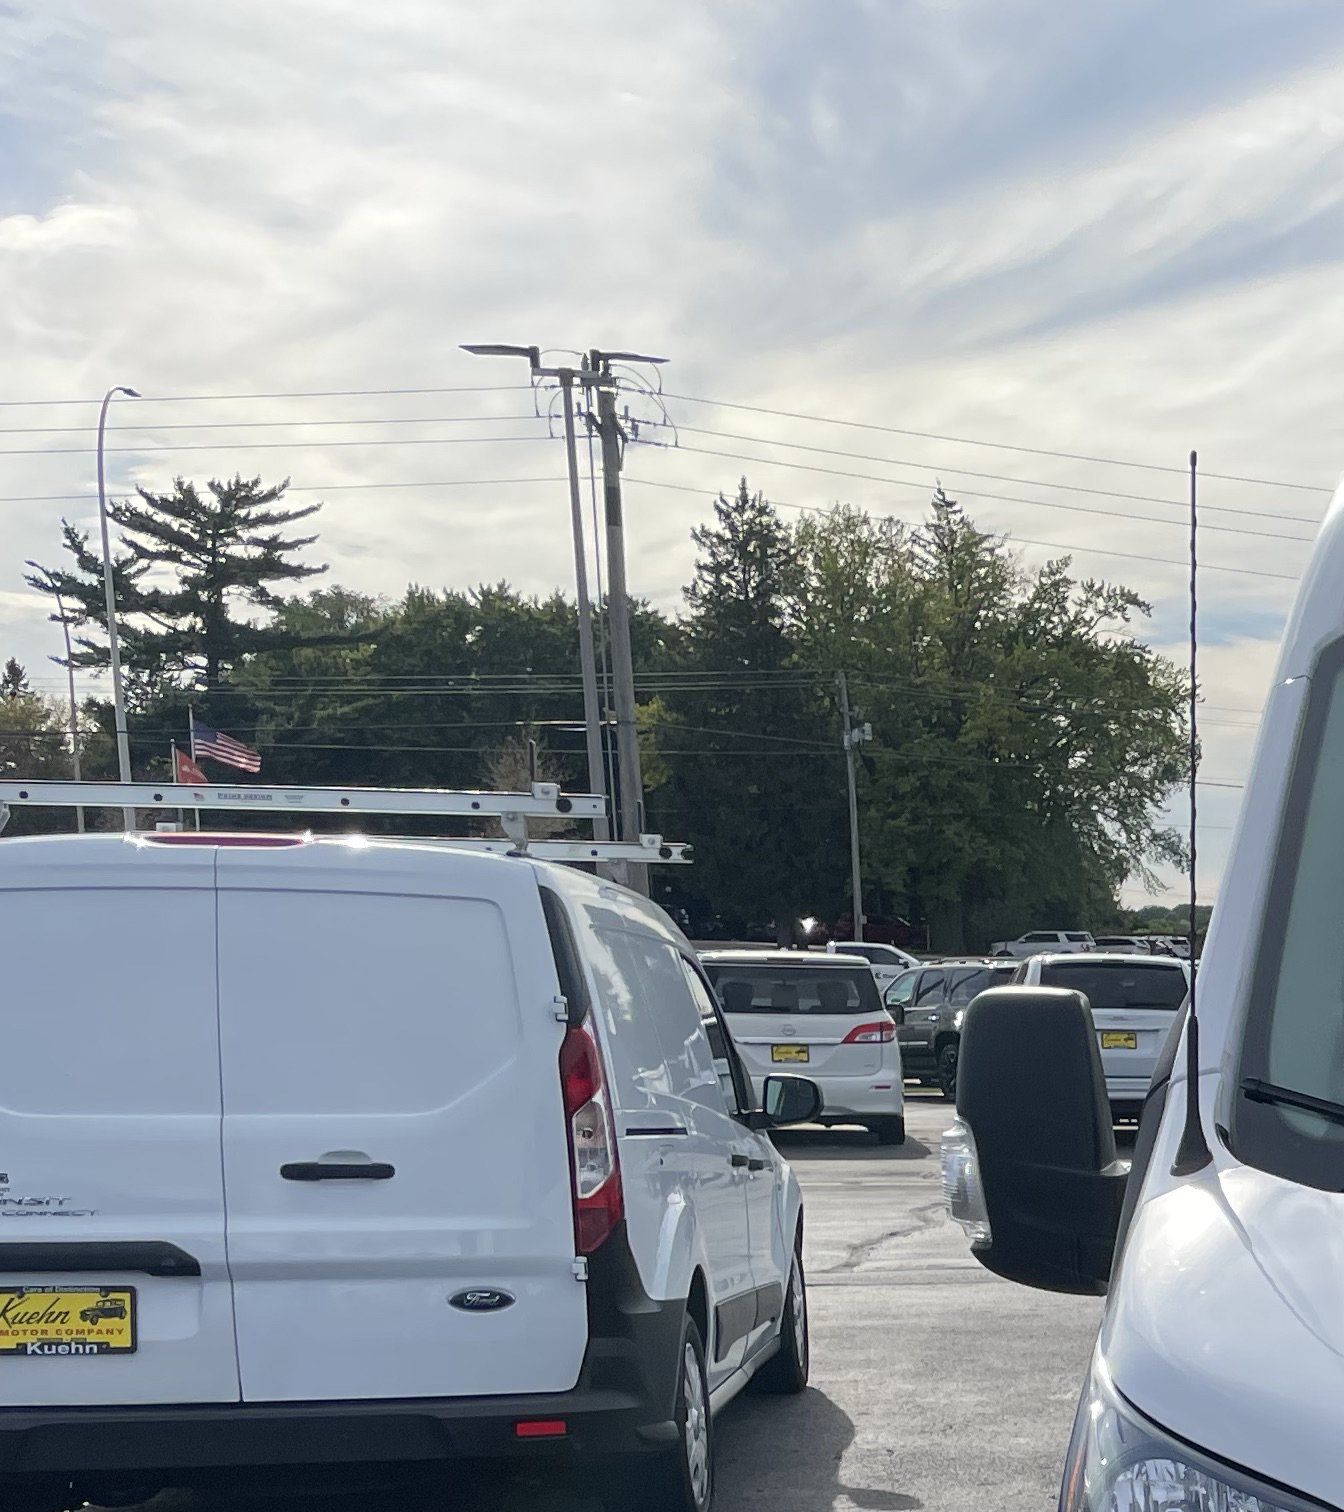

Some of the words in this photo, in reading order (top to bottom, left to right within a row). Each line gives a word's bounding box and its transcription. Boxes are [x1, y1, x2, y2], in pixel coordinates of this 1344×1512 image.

[0, 1297, 71, 1329] Kuehn
[0, 1329, 49, 1337] MOTOR
[55, 1327, 125, 1337] COMPANY
[26, 1341, 98, 1355] Kuehn
